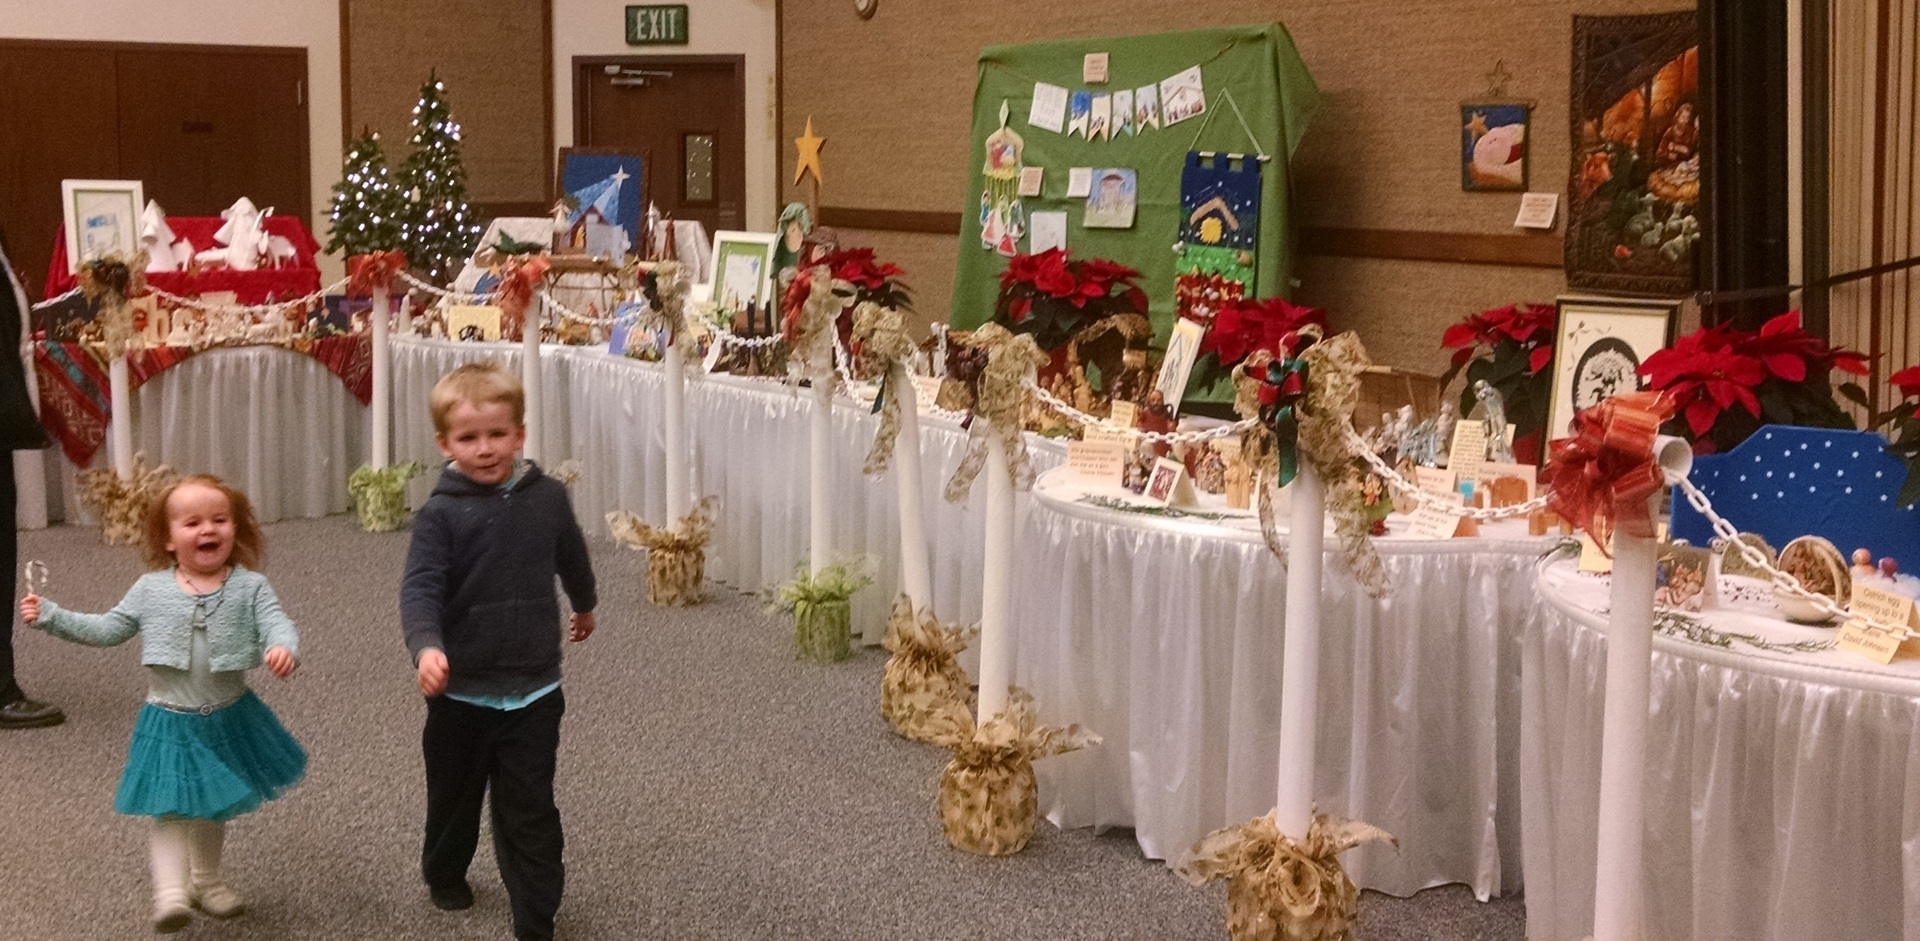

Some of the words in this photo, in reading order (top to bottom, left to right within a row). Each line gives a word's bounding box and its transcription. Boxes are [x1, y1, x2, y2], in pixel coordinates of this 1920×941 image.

[636, 9, 677, 40] EXIT
[1855, 600, 1880, 614] opening
[1881, 607, 1891, 617] up
[1891, 609, 1898, 618] to
[1888, 597, 1900, 608] egg
[1843, 632, 1862, 644] David
